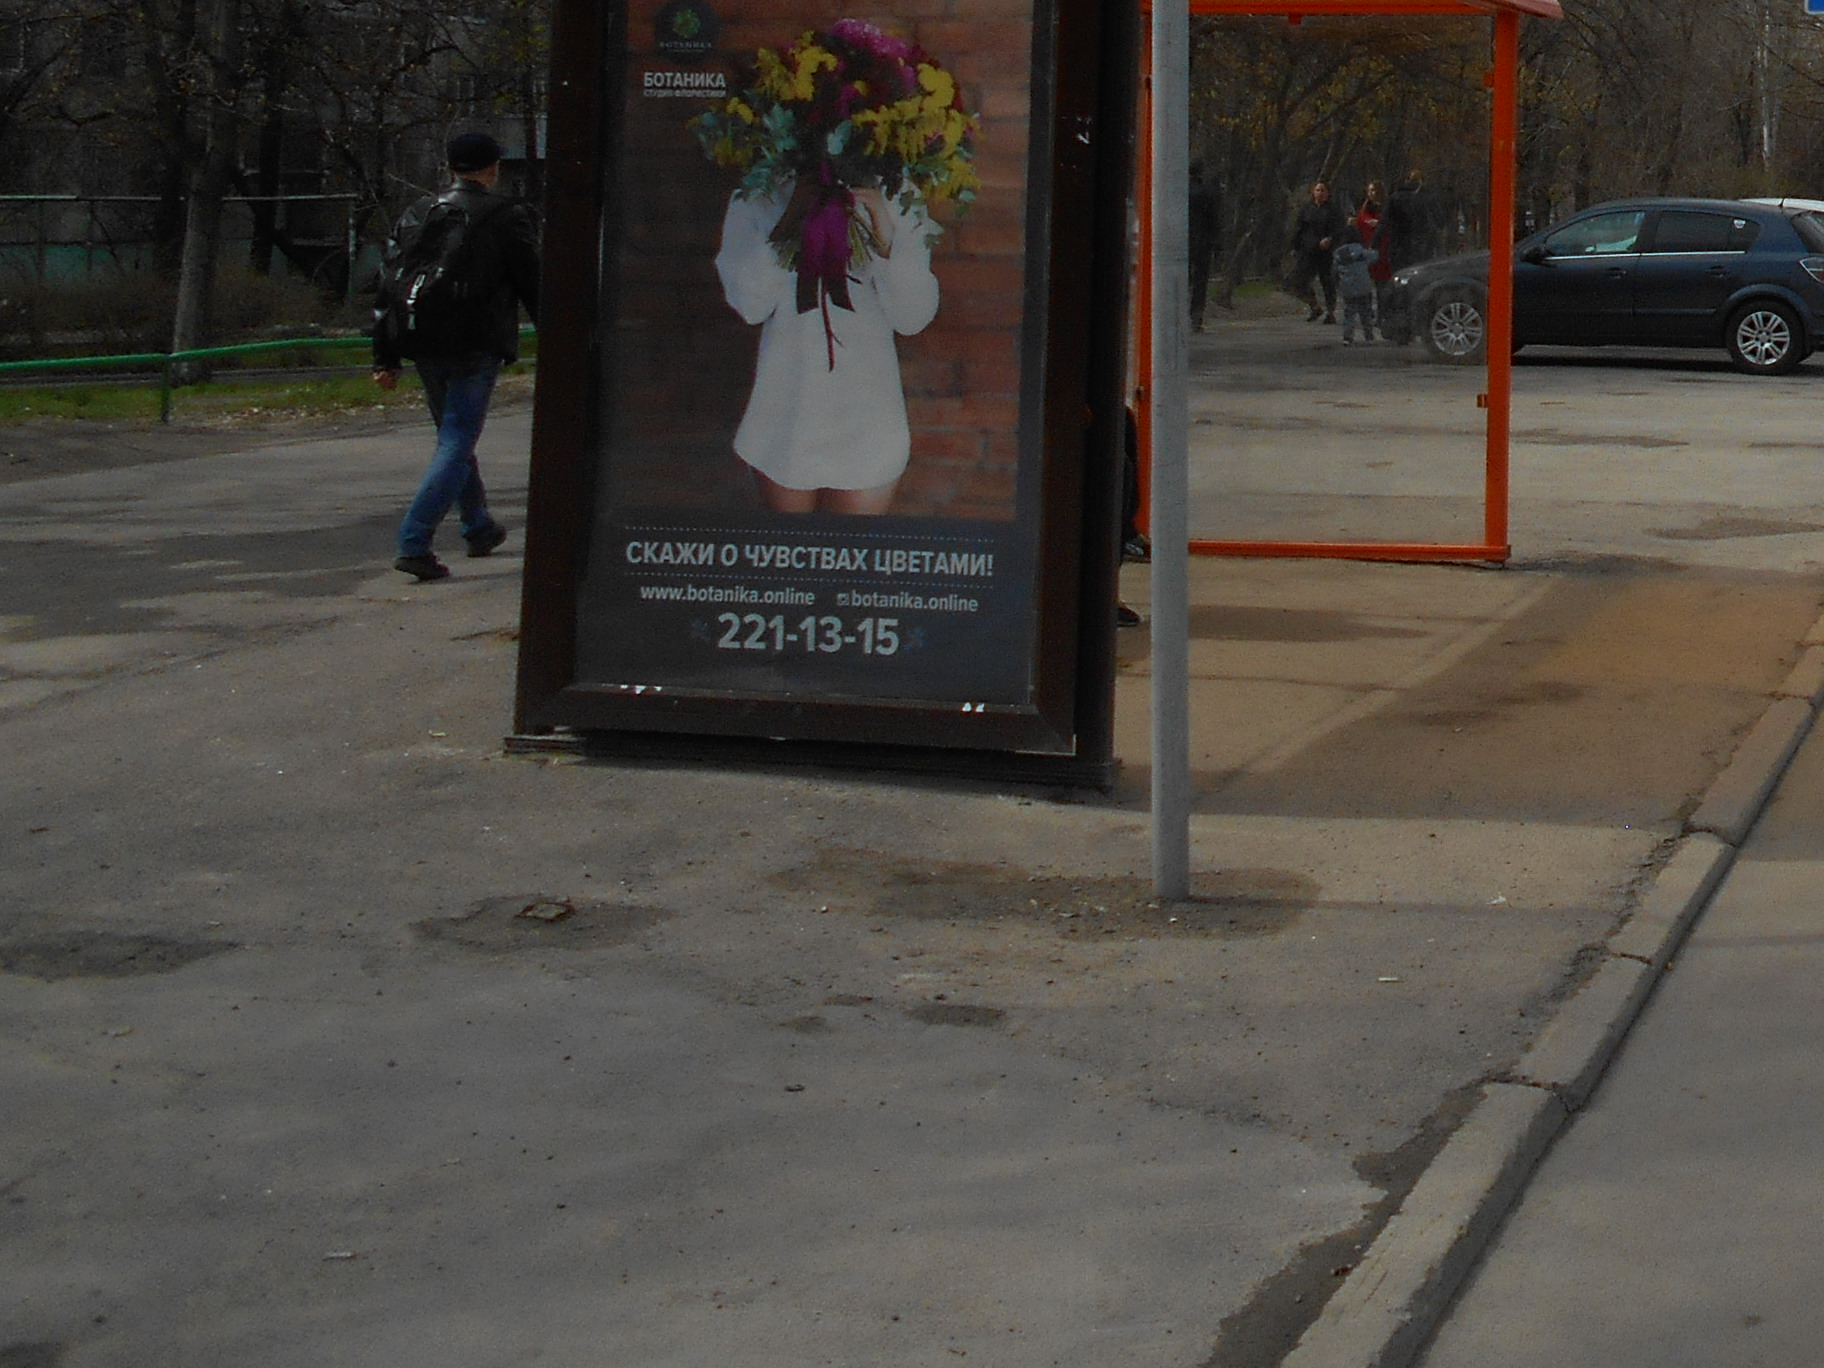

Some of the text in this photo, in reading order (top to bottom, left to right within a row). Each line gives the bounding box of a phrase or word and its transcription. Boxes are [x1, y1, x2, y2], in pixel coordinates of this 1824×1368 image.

[643, 71, 726, 88] БОТАНИКА
[626, 541, 994, 576] СКАЖИ О ЧУВСТВАХ ЦВЕТАМИ!
[640, 584, 815, 606] www.botanika.online
[717, 612, 900, 656] 221-13-15
